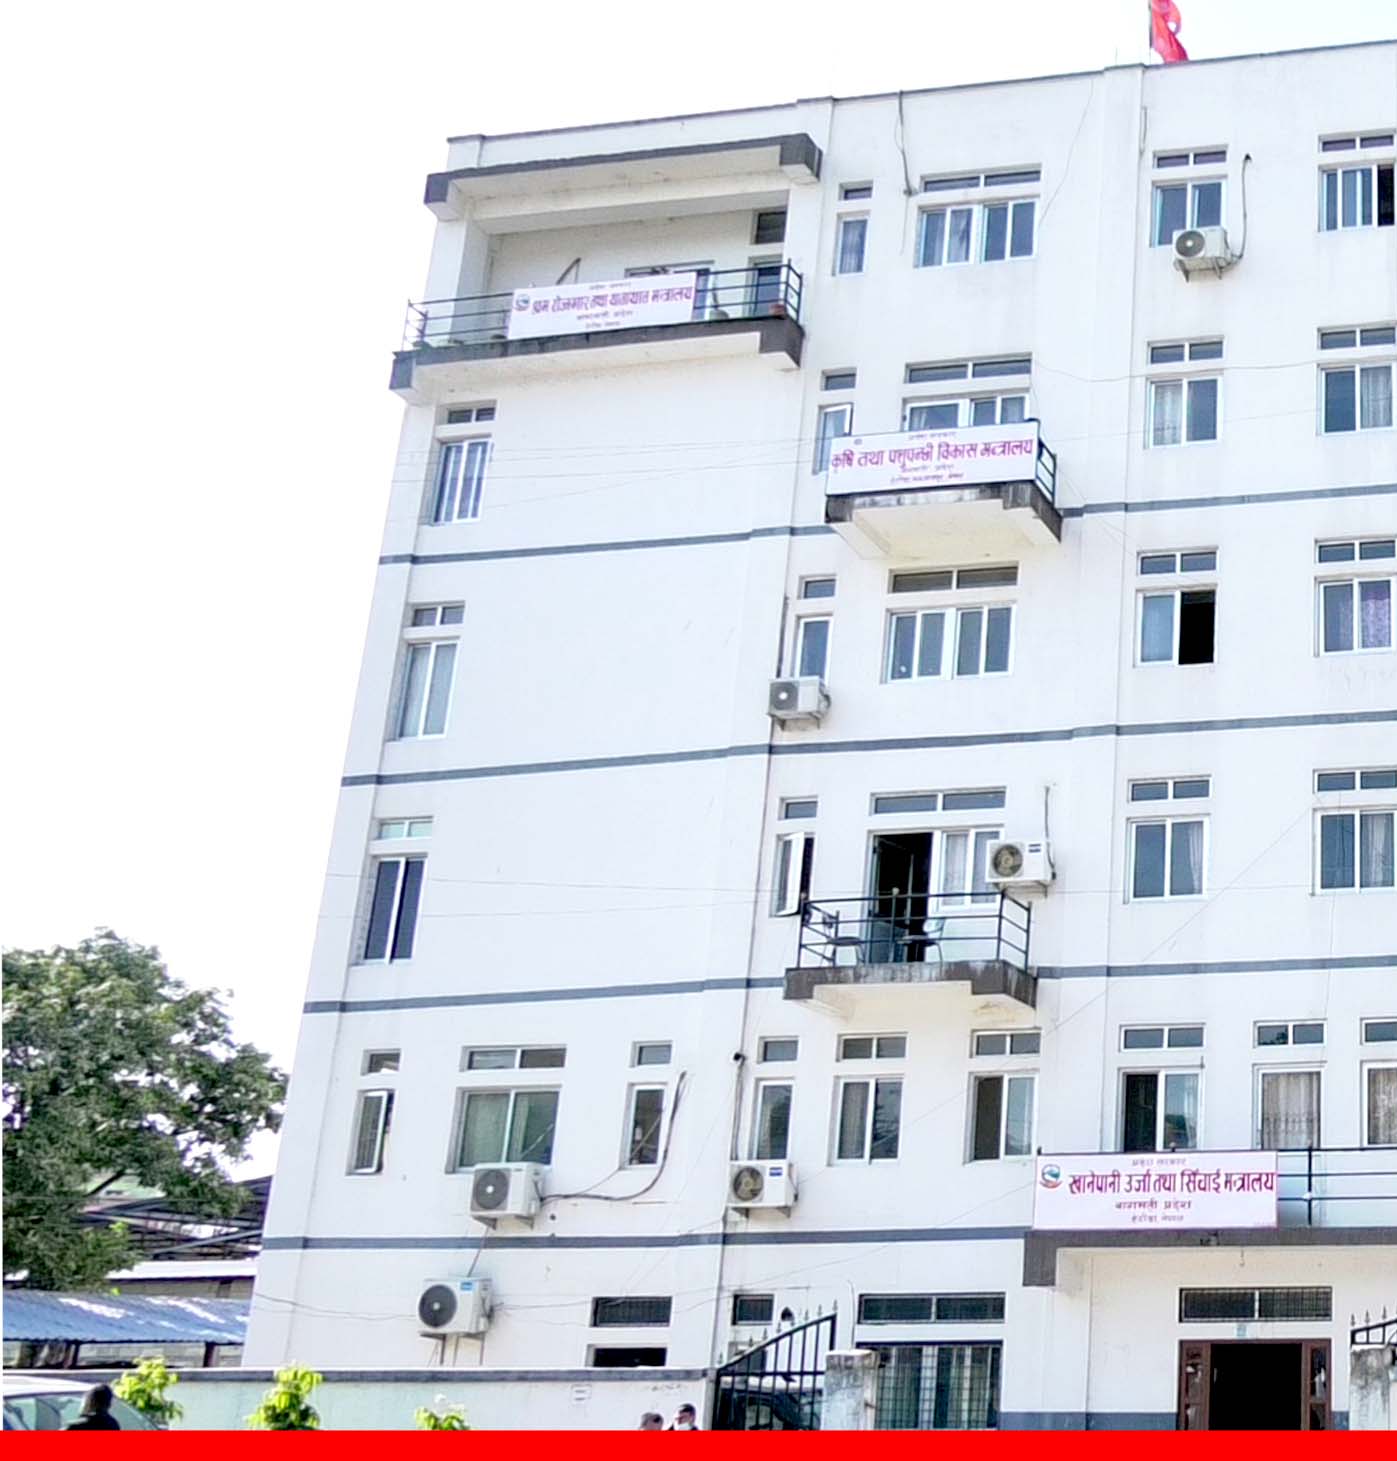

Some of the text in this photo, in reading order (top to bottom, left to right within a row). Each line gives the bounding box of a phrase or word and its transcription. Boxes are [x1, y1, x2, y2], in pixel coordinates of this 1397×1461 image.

[831, 448, 854, 474] कृषि
[857, 450, 884, 467] तथा
[938, 441, 978, 461] विकास
[980, 438, 1034, 458] मन्त्रालय
[1068, 1168, 1276, 1194] खानेपानी उर्जा तथा सिंचाई मन्त्रालय
